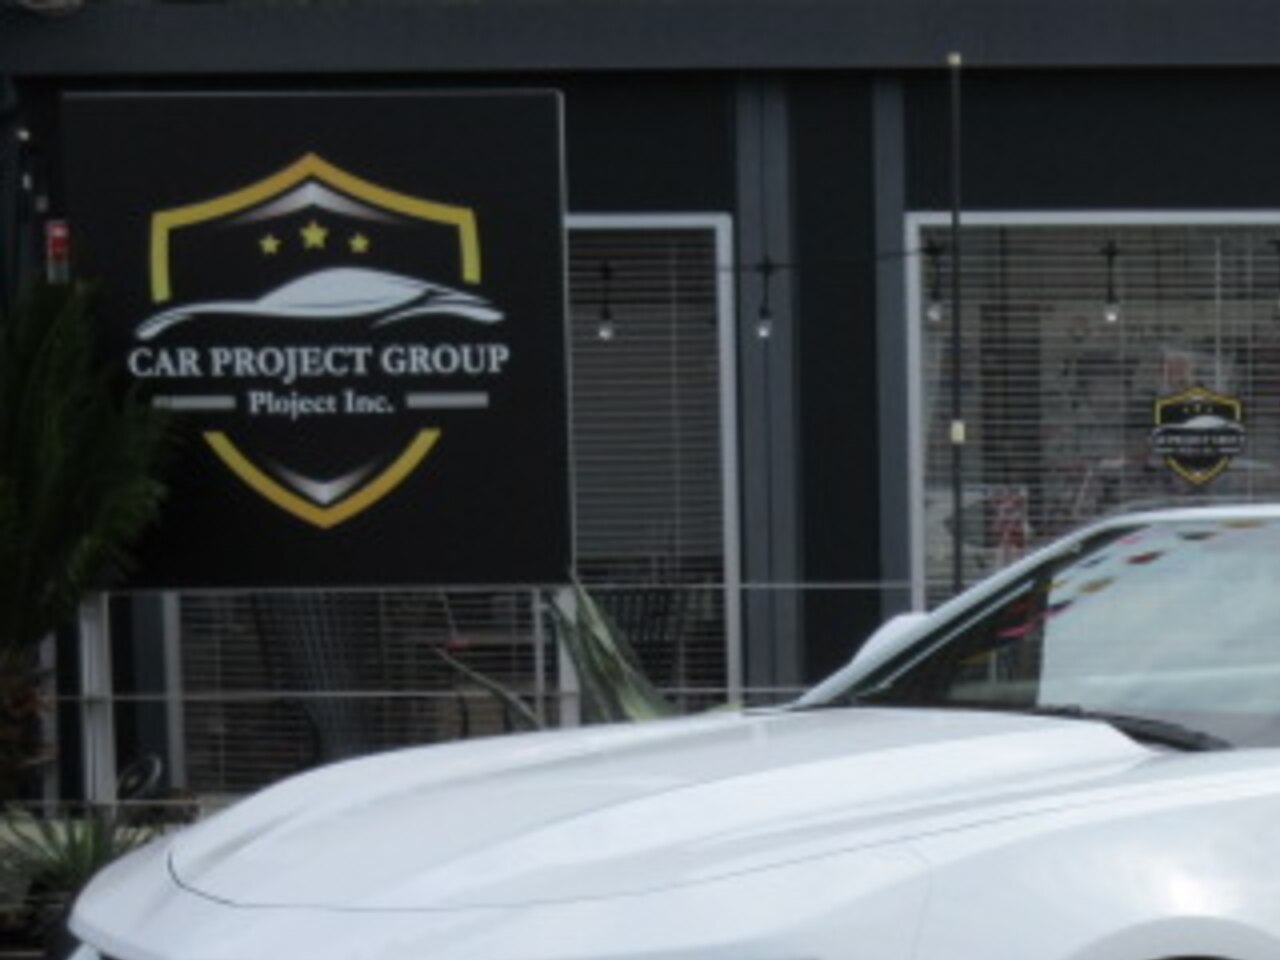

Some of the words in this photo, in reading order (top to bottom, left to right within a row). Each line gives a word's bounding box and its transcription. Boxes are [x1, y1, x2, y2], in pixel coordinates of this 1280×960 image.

[128, 347, 203, 376] CAR
[210, 345, 372, 384] PROJECT
[380, 344, 510, 374] GROUP
[248, 390, 336, 421] Ploject
[343, 389, 395, 413] Inc.
